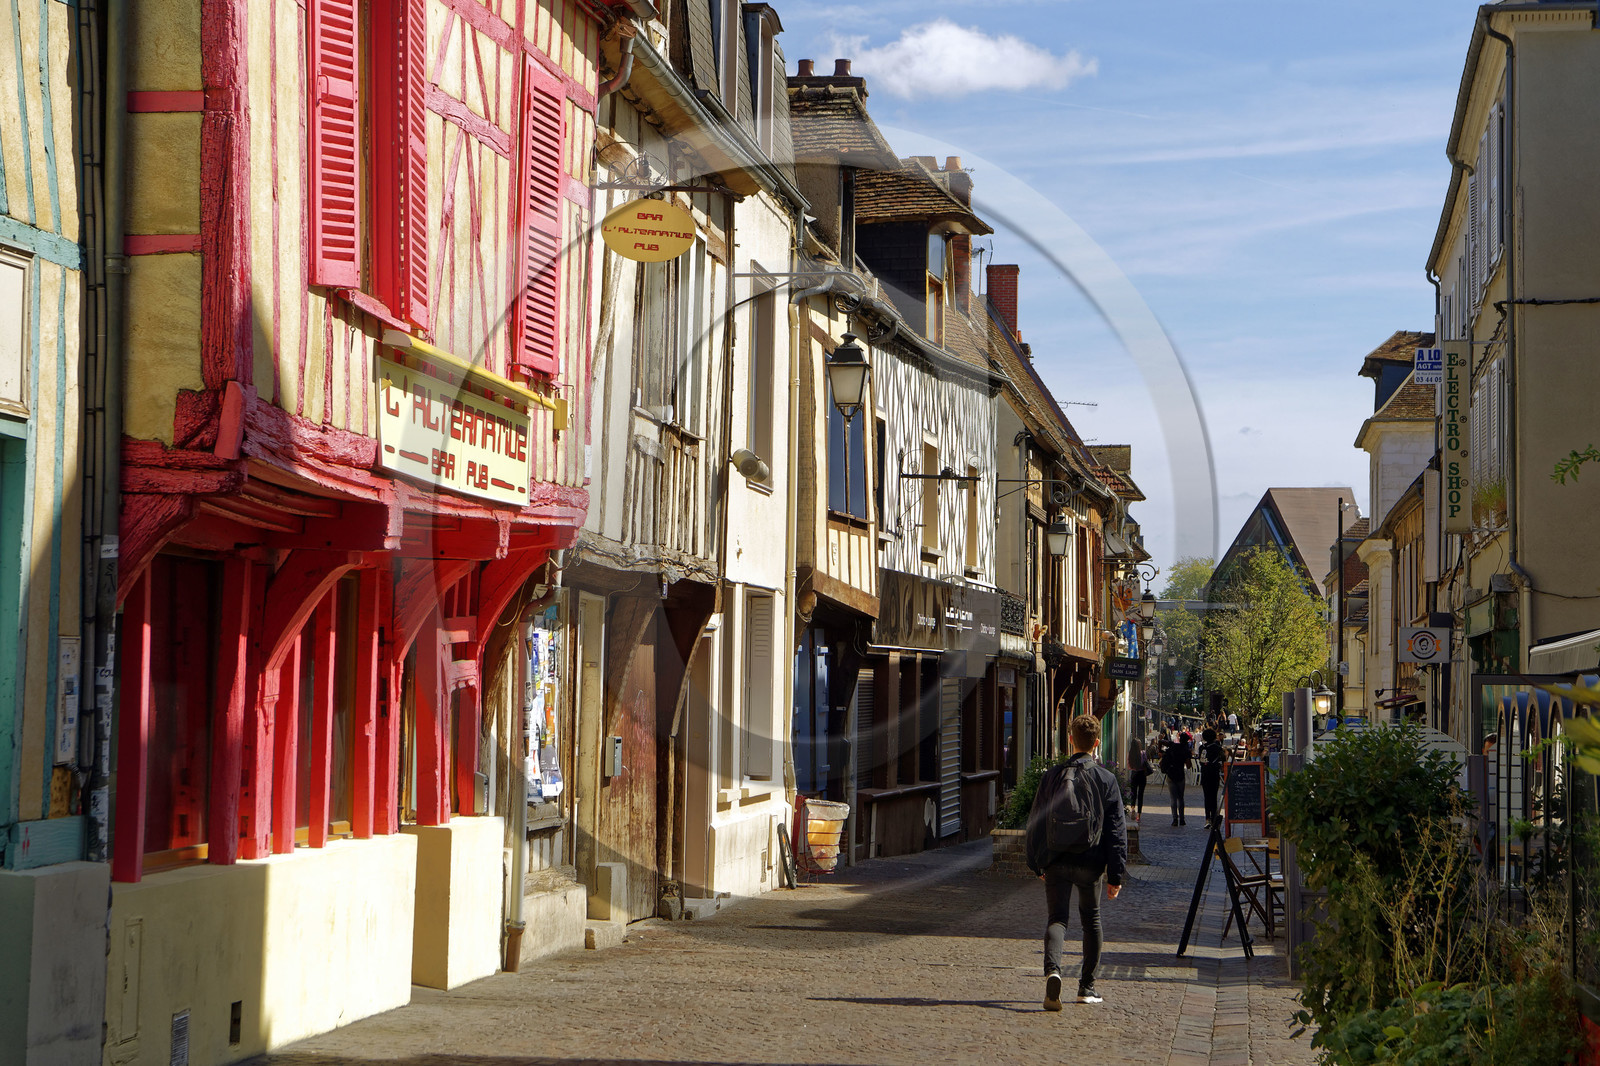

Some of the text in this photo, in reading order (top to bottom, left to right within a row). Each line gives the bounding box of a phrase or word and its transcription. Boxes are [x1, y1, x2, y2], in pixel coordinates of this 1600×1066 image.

[637, 212, 663, 221] BAR
[604, 225, 693, 239] L'ALTERNATIVE
[634, 242, 659, 251] PUB
[1417, 349, 1442, 360] A LO
[1446, 353, 1460, 451] ELECTRO
[385, 372, 528, 463] L'ALTERNATIVE
[431, 447, 488, 490] BAR PUB
[1448, 462, 1461, 517] SHOP
